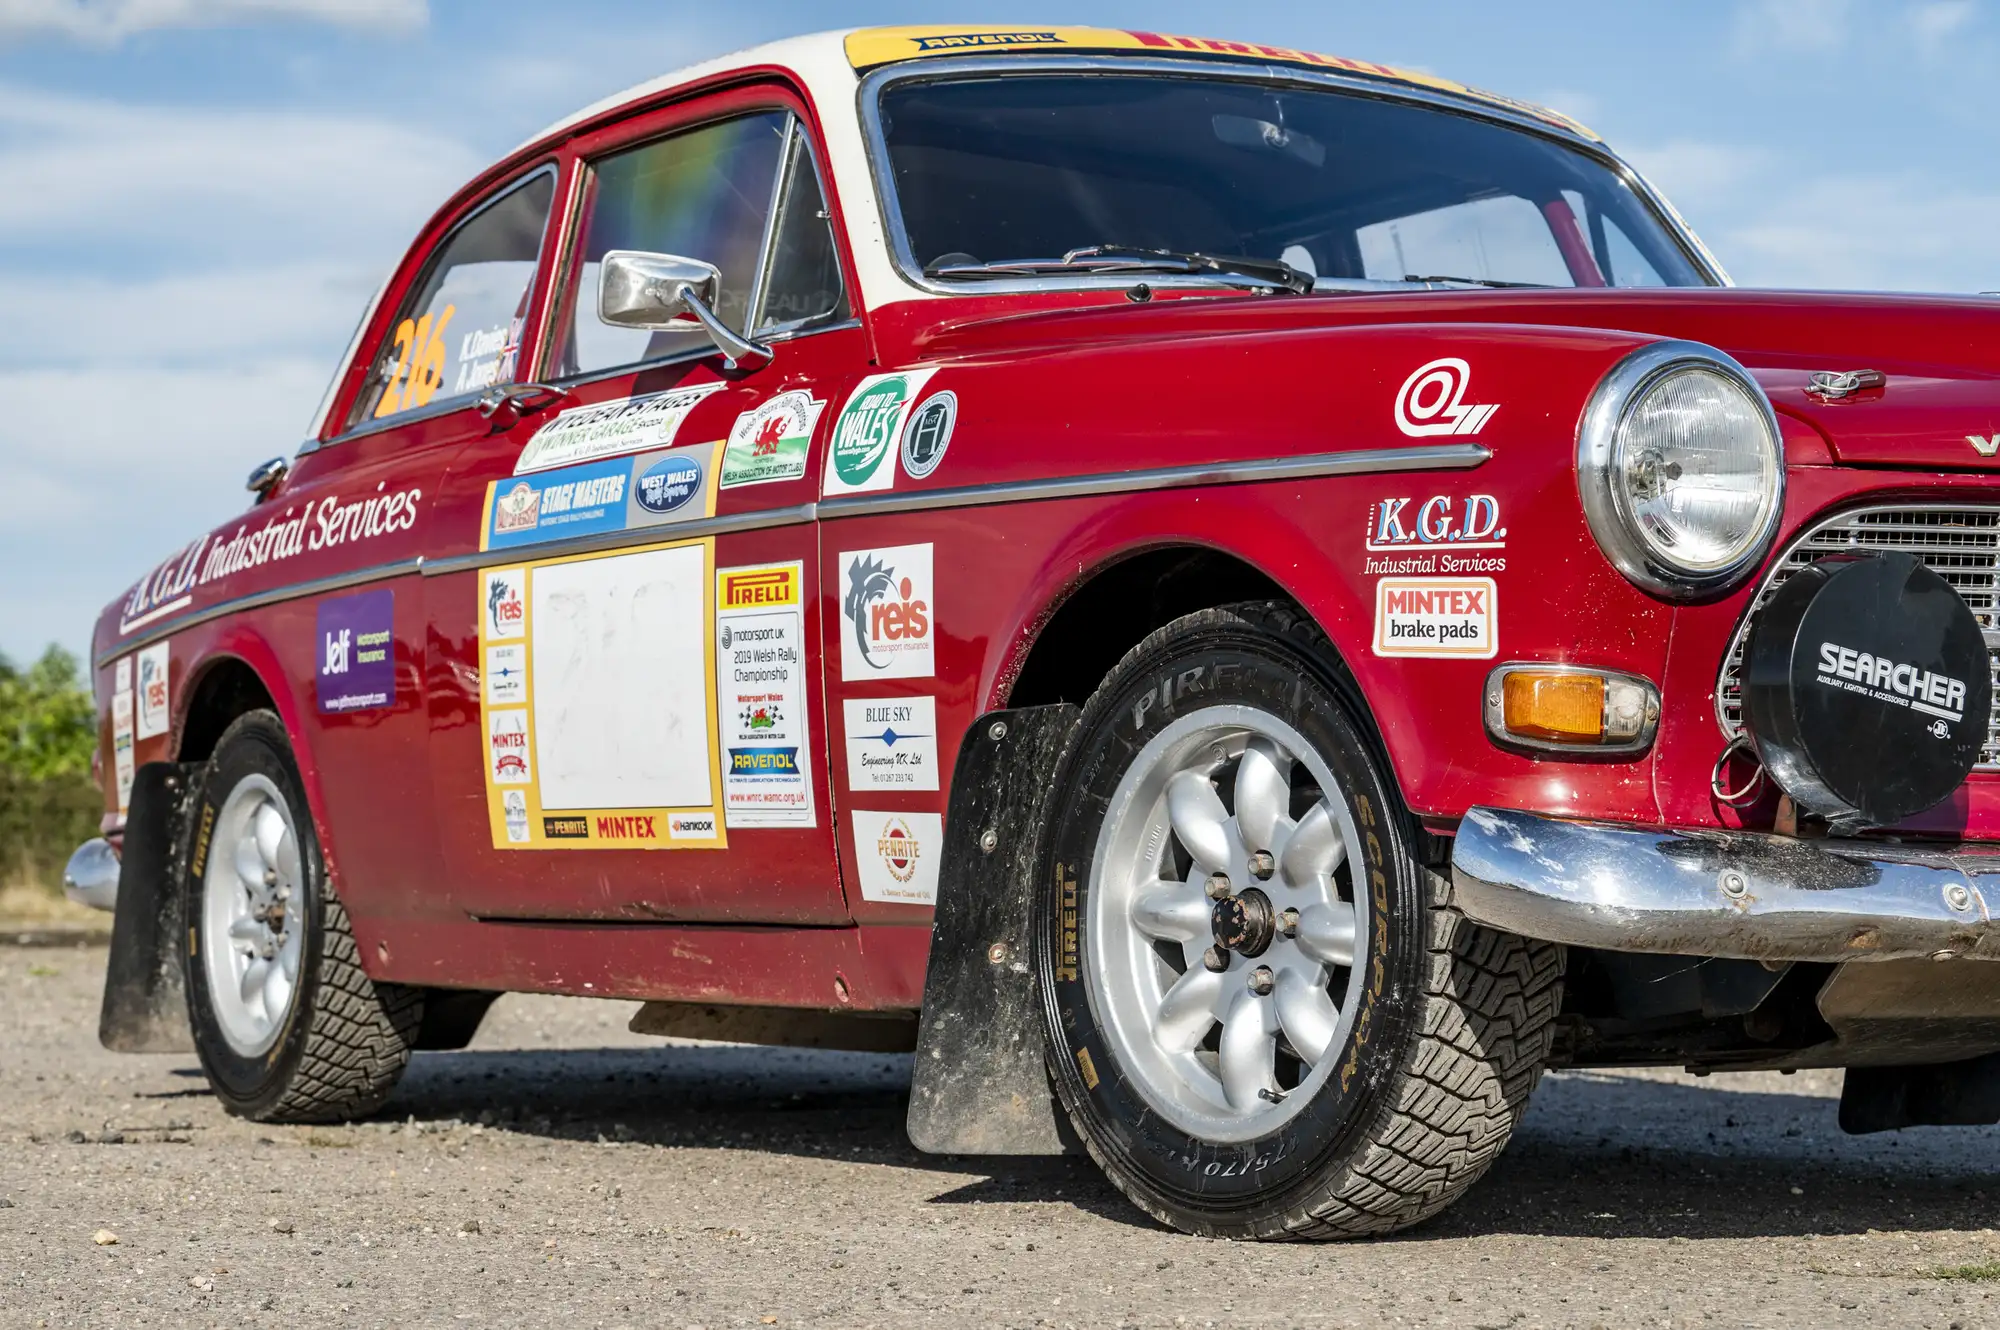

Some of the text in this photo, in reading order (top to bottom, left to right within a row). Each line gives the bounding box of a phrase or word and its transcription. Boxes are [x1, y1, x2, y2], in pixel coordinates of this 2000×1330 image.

[923, 33, 1056, 48] RAVENOL
[374, 304, 456, 418] 216
[627, 392, 705, 417] STAGES
[590, 417, 641, 443] GARAGE
[838, 404, 895, 449] WALES
[912, 407, 947, 458] H
[641, 468, 697, 490] WEST WALES
[541, 486, 575, 515] STAGE
[573, 474, 626, 508] MASTERS
[1375, 494, 1508, 544] K.G.D.
[199, 500, 316, 584] Industrial
[309, 481, 422, 551] Services
[1364, 553, 1506, 574] Industrial Services
[727, 571, 790, 605] PIRELLI
[499, 589, 522, 621] reis
[872, 577, 928, 641] reis
[1387, 591, 1484, 615] MINTEX
[733, 628, 785, 642] motorsport uk
[1390, 619, 1478, 643] brake pads
[322, 629, 351, 675] Jelf
[734, 646, 797, 664] 2019 Welsh Rally
[872, 641, 929, 654] motorsport insurance
[734, 666, 788, 684] Championship
[1817, 642, 1967, 711] SEARCHER
[737, 693, 783, 704] Motorsport Wales
[1130, 662, 1303, 731] PIREI
[1816, 674, 1909, 707] AUXILIARY LIGHTING & ACCESSORIES
[866, 706, 912, 722] BLUE SKY
[492, 733, 526, 748] MINTEX
[734, 753, 794, 769] RAVENOL
[861, 752, 894, 769] Engineering
[910, 752, 922, 765] Ltd
[895, 773, 904, 782] 233
[554, 820, 587, 834] PENRITE
[597, 816, 657, 839] MINTEX
[878, 839, 920, 858] PENRITE
